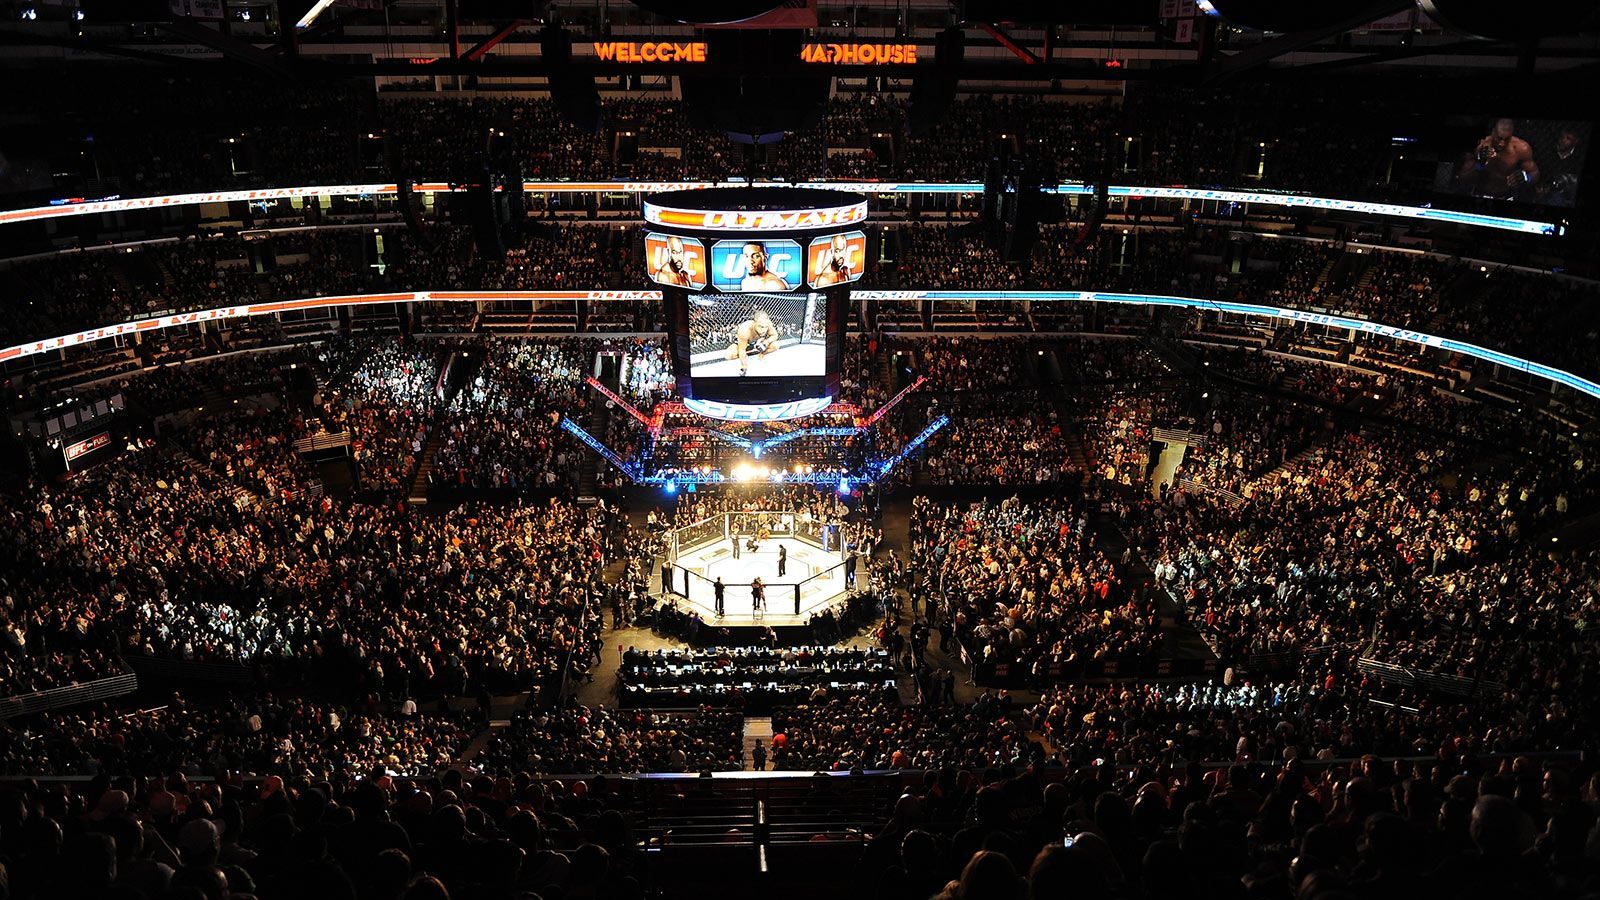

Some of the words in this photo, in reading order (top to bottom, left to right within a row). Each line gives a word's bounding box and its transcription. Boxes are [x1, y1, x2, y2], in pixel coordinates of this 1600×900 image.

[594, 42, 706, 62] WELCOME
[653, 246, 697, 277] UC
[722, 253, 792, 279] UC
[814, 243, 859, 276] UC
[69, 442, 87, 458] UFC
